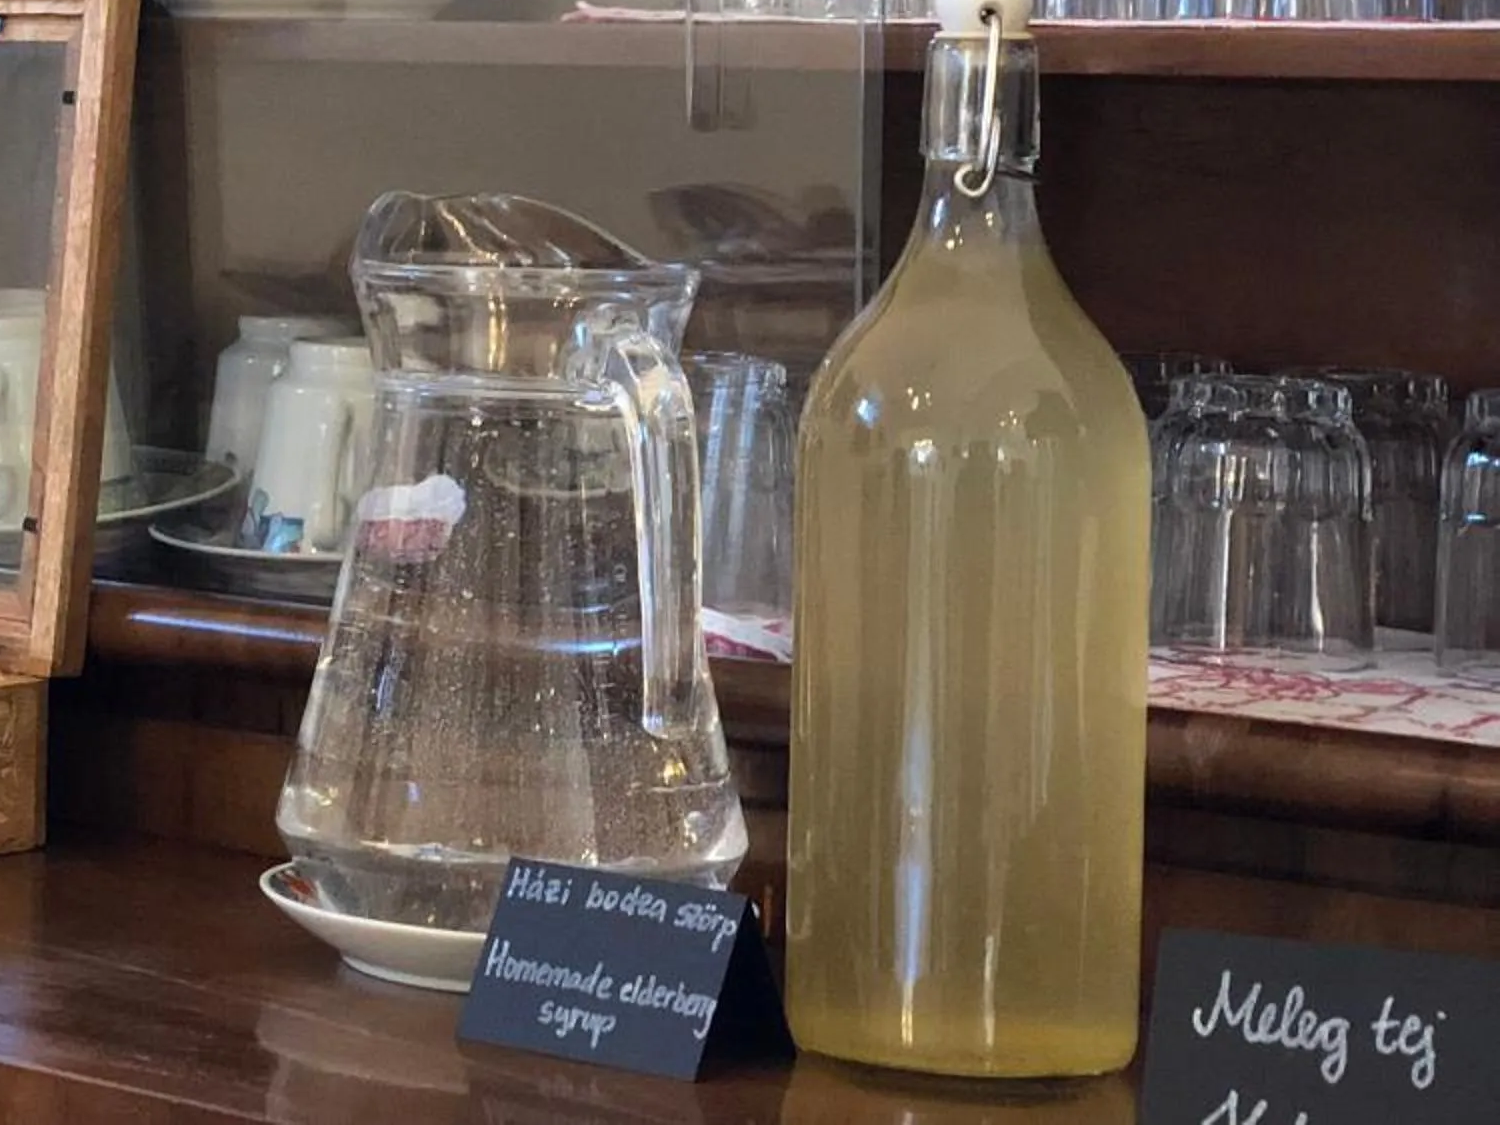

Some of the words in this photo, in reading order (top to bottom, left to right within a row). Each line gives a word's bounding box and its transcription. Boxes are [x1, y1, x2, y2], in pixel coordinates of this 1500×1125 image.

[507, 866, 572, 905] Házi
[585, 879, 668, 924] bodza
[673, 903, 738, 953] szörp
[485, 937, 613, 1000] Homemade
[537, 999, 617, 1049] syrup
[1193, 969, 1350, 1083] Meleg
[1371, 995, 1447, 1089] tej
